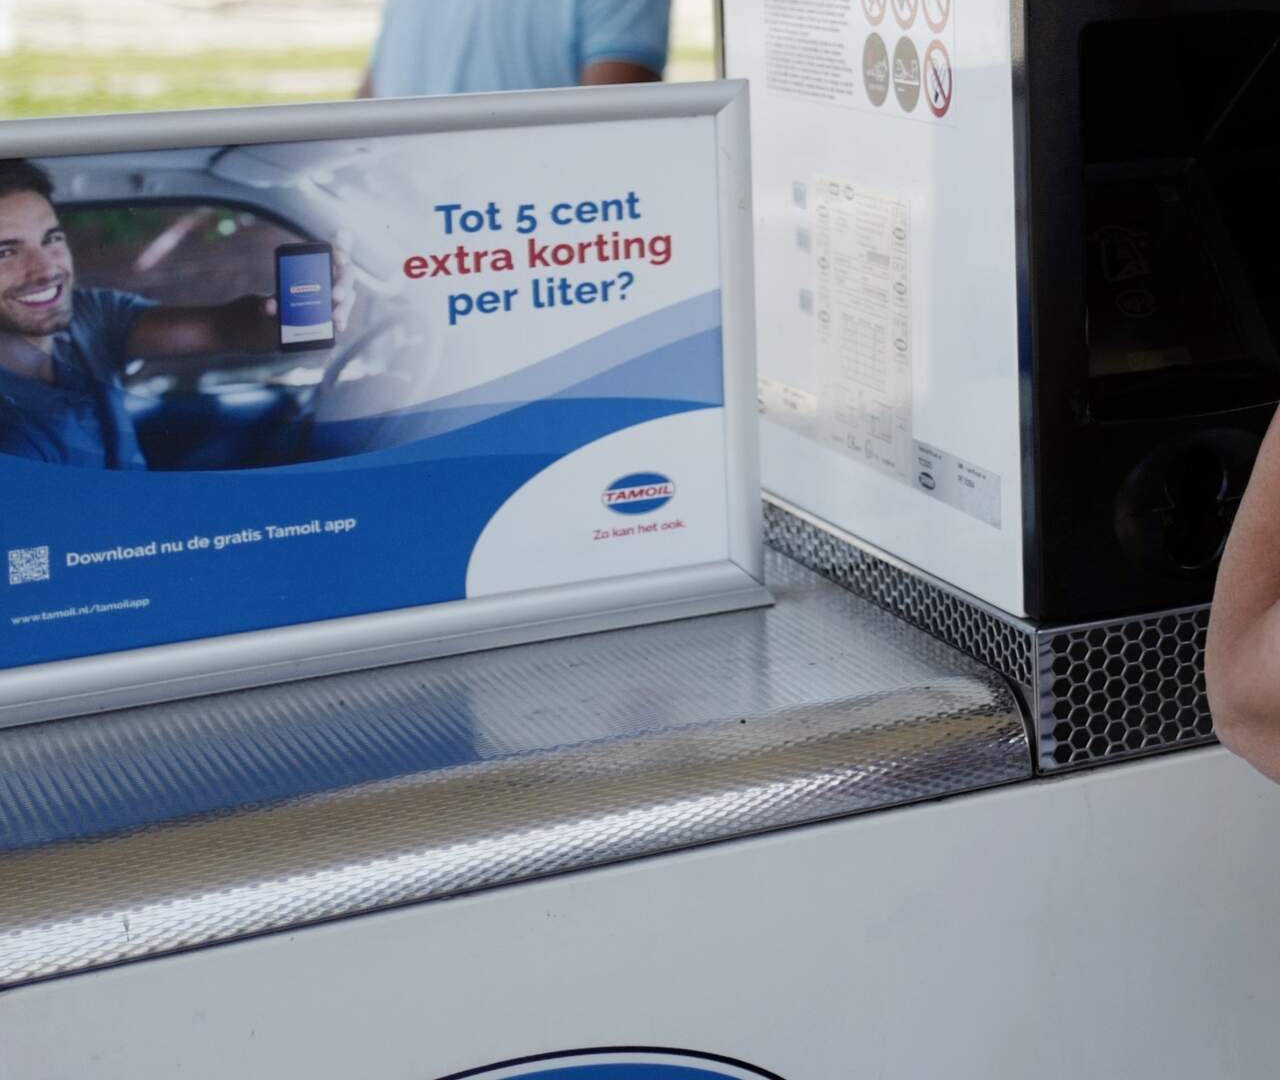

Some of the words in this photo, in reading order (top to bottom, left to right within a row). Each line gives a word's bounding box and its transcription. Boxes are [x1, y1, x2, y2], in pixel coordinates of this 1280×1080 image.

[434, 202, 502, 235] Tot
[515, 204, 538, 235] 5
[549, 191, 641, 226] cent
[402, 245, 515, 280] extra
[527, 231, 673, 267] korting
[447, 288, 519, 326] per
[531, 271, 635, 309] liter?
[606, 485, 673, 502] TAMOIL
[65, 542, 157, 567] Download
[160, 539, 183, 555] nu
[186, 535, 210, 550] de
[213, 528, 263, 551] gratis
[265, 520, 322, 540] Tamoil
[323, 518, 357, 533] app
[592, 529, 609, 541] Zo
[612, 526, 635, 538] kan
[637, 522, 658, 533] het
[9, 596, 151, 626] www.tamoil.nl/tamoilapp
